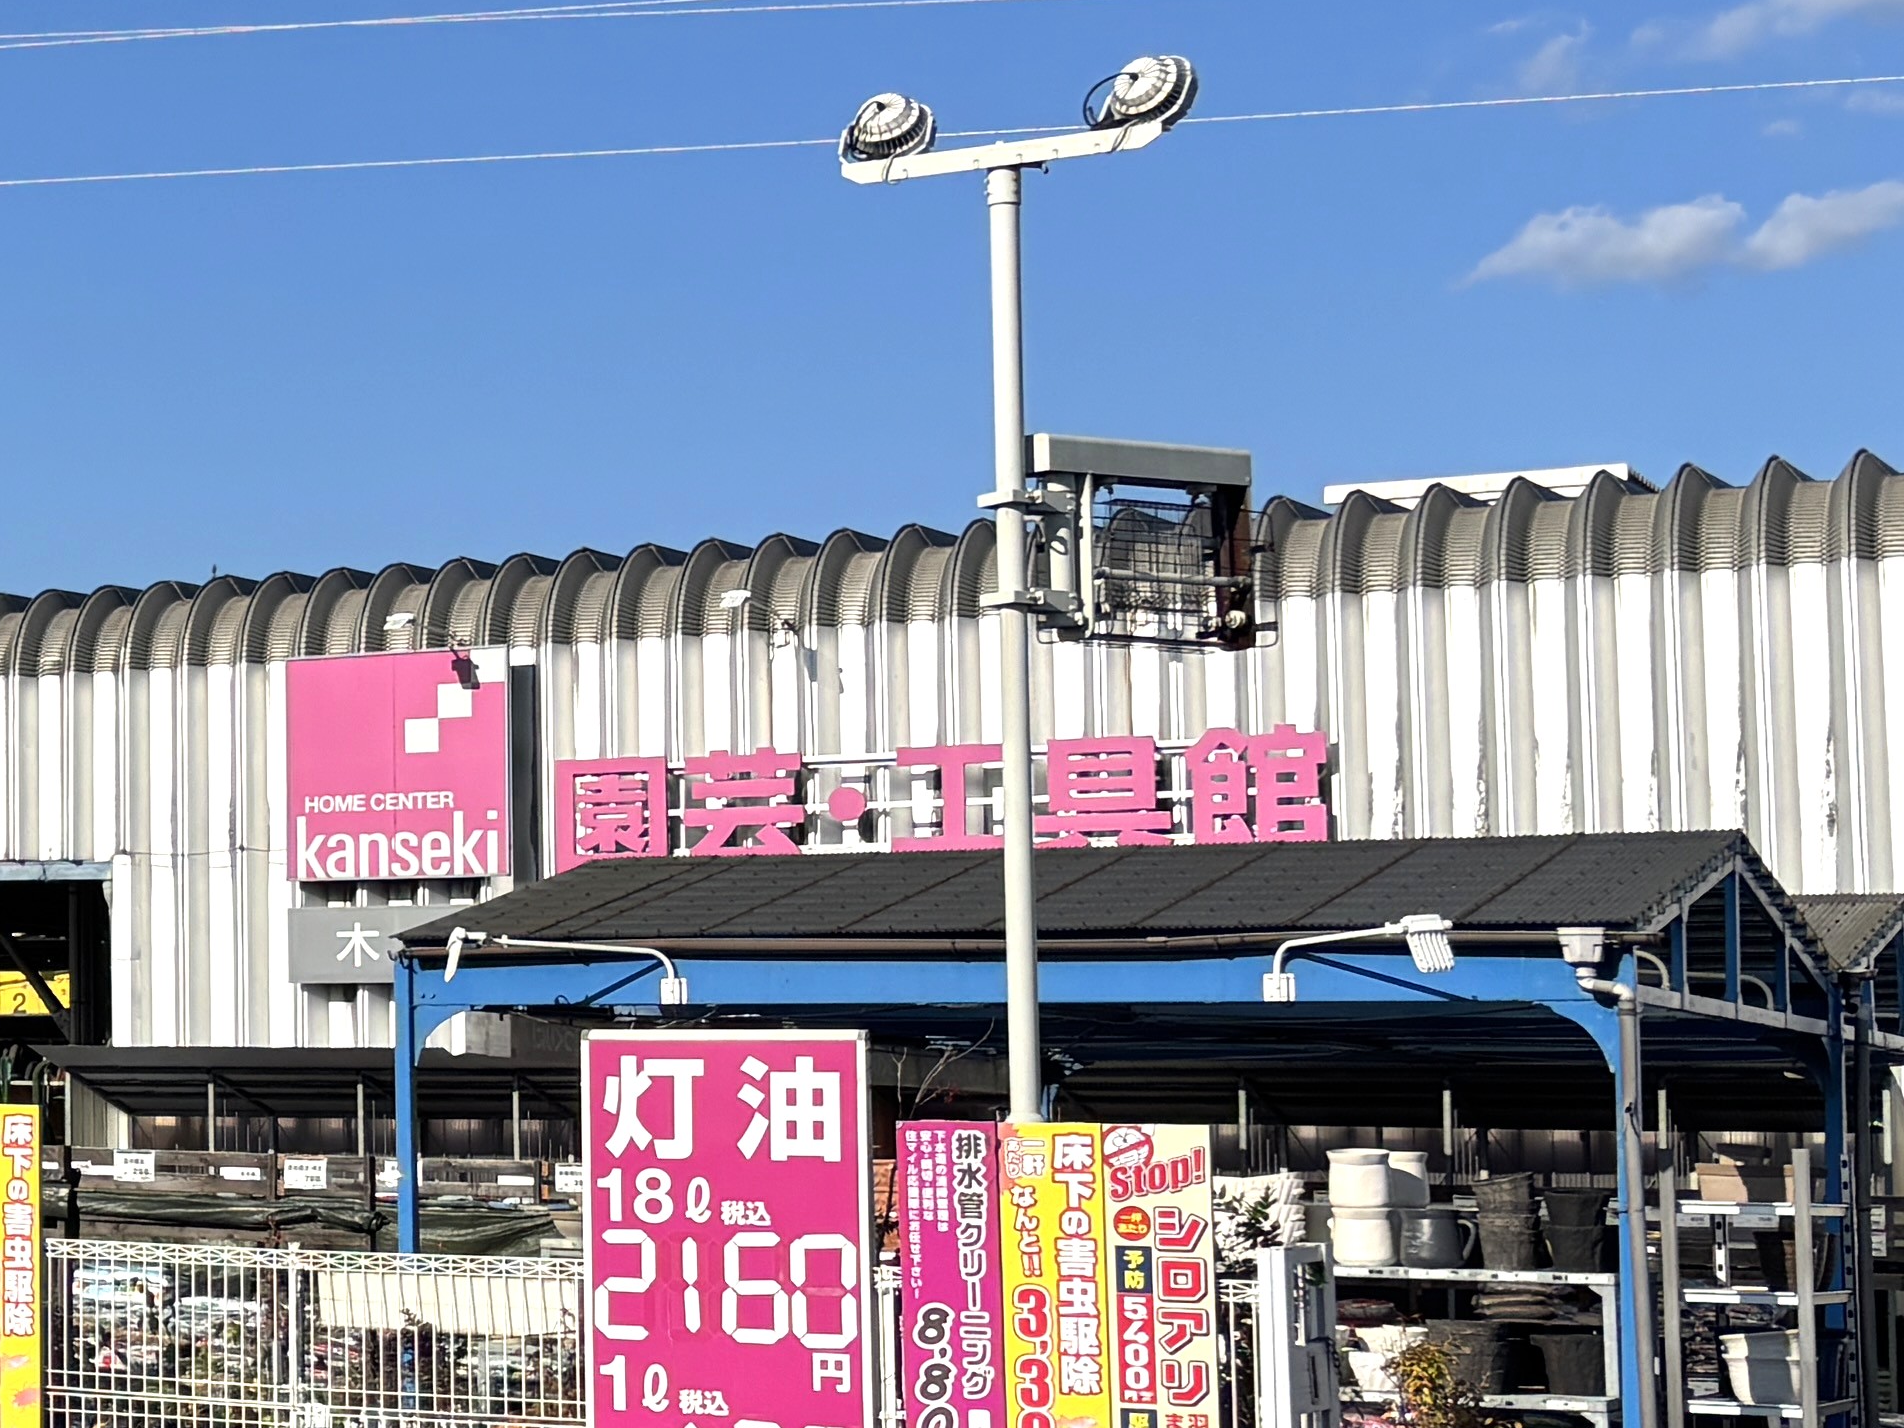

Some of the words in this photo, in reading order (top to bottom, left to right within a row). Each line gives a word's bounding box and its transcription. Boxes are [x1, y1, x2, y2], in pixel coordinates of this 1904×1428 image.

[304, 793, 366, 814] HOME
[370, 791, 454, 811] CENTER
[297, 810, 499, 877] kanseki
[12, 992, 27, 1014] 2
[602, 1054, 842, 1163] 灯油
[1109, 1146, 1206, 1202] Stop!
[2, 1113, 35, 1337] 床下の害虫駆除
[720, 1200, 771, 1227] 税込
[1010, 1184, 1043, 1278] なんと!!
[594, 1229, 858, 1350] 2160
[951, 1129, 994, 1400] 排水管クリーニング
[1051, 1132, 1104, 1396] 床下の害虫駆除
[1123, 1249, 1145, 1290] 予防
[1153, 1205, 1211, 1409] シロアリ
[678, 1389, 730, 1416] 税込
[812, 1352, 852, 1394] 円
